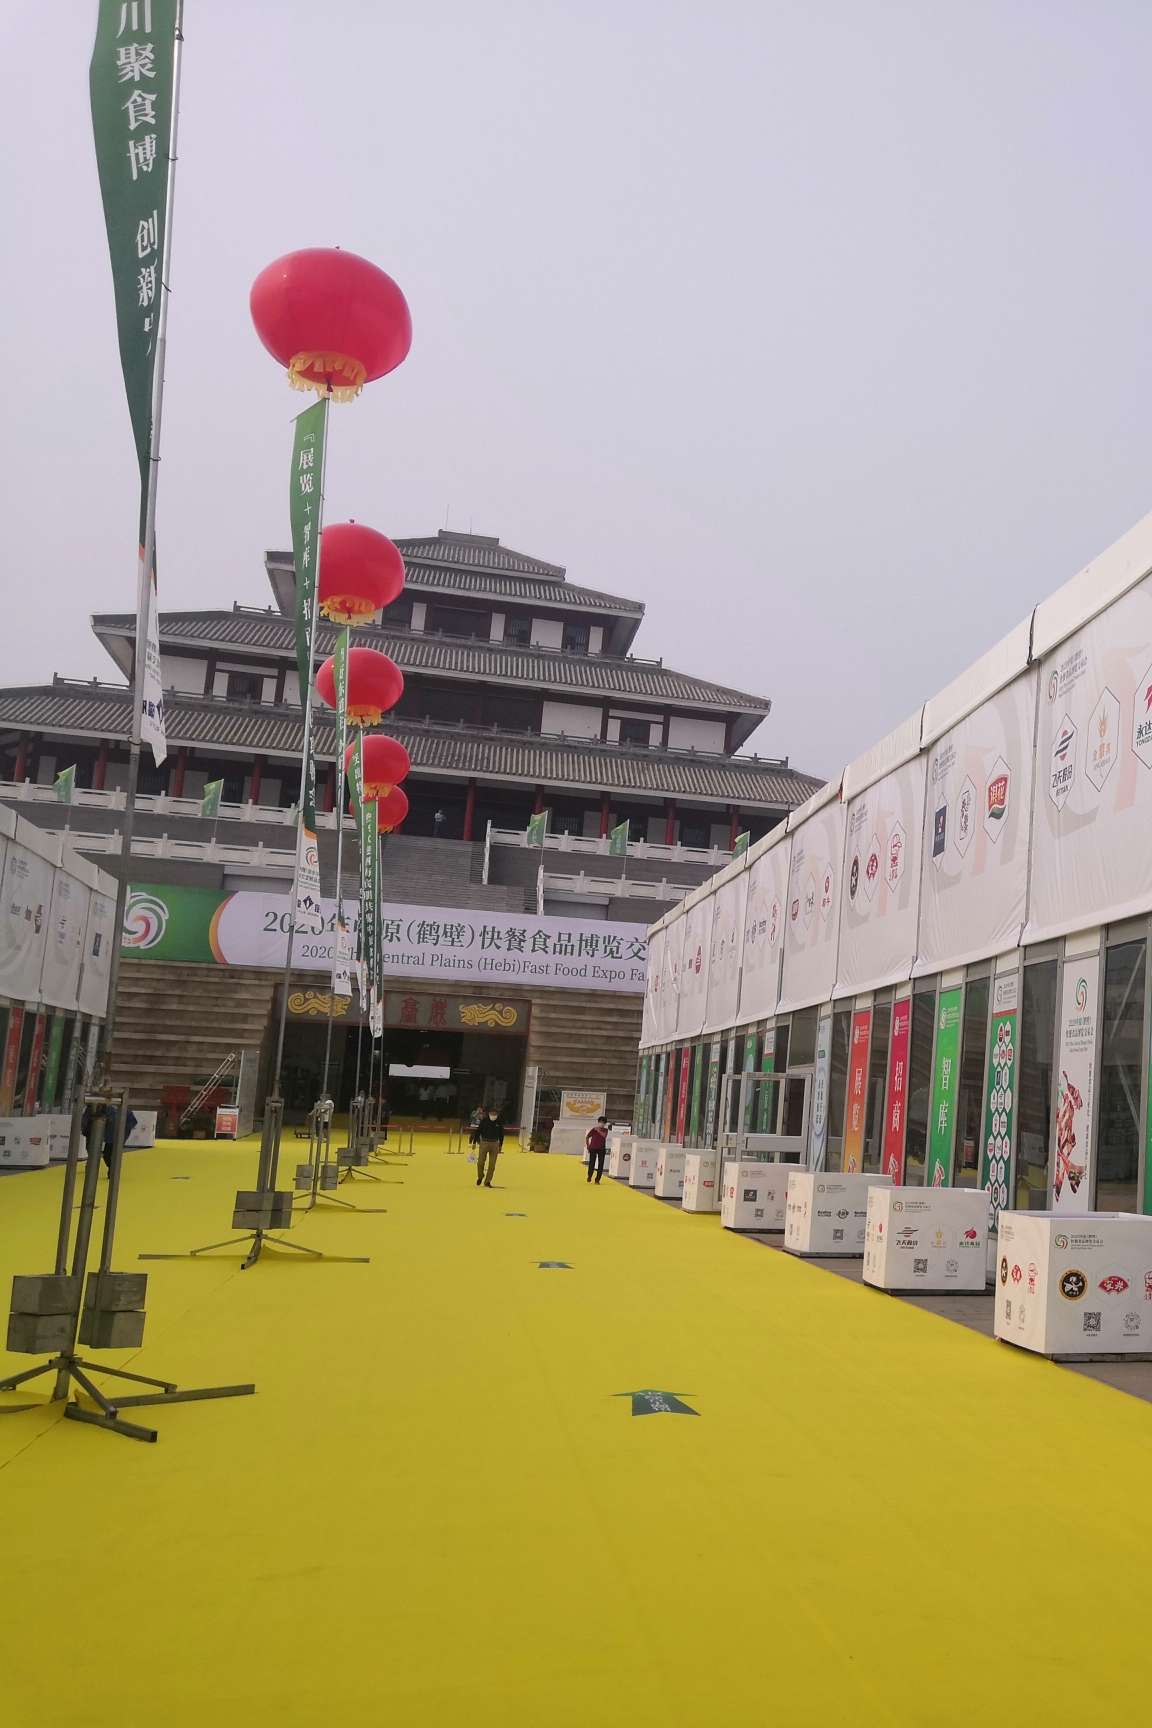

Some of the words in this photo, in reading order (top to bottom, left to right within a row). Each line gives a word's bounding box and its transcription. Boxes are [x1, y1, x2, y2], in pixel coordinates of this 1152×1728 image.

[430, 951, 474, 970] Plains
[554, 961, 588, 978] Food
[591, 965, 626, 984] Expo
